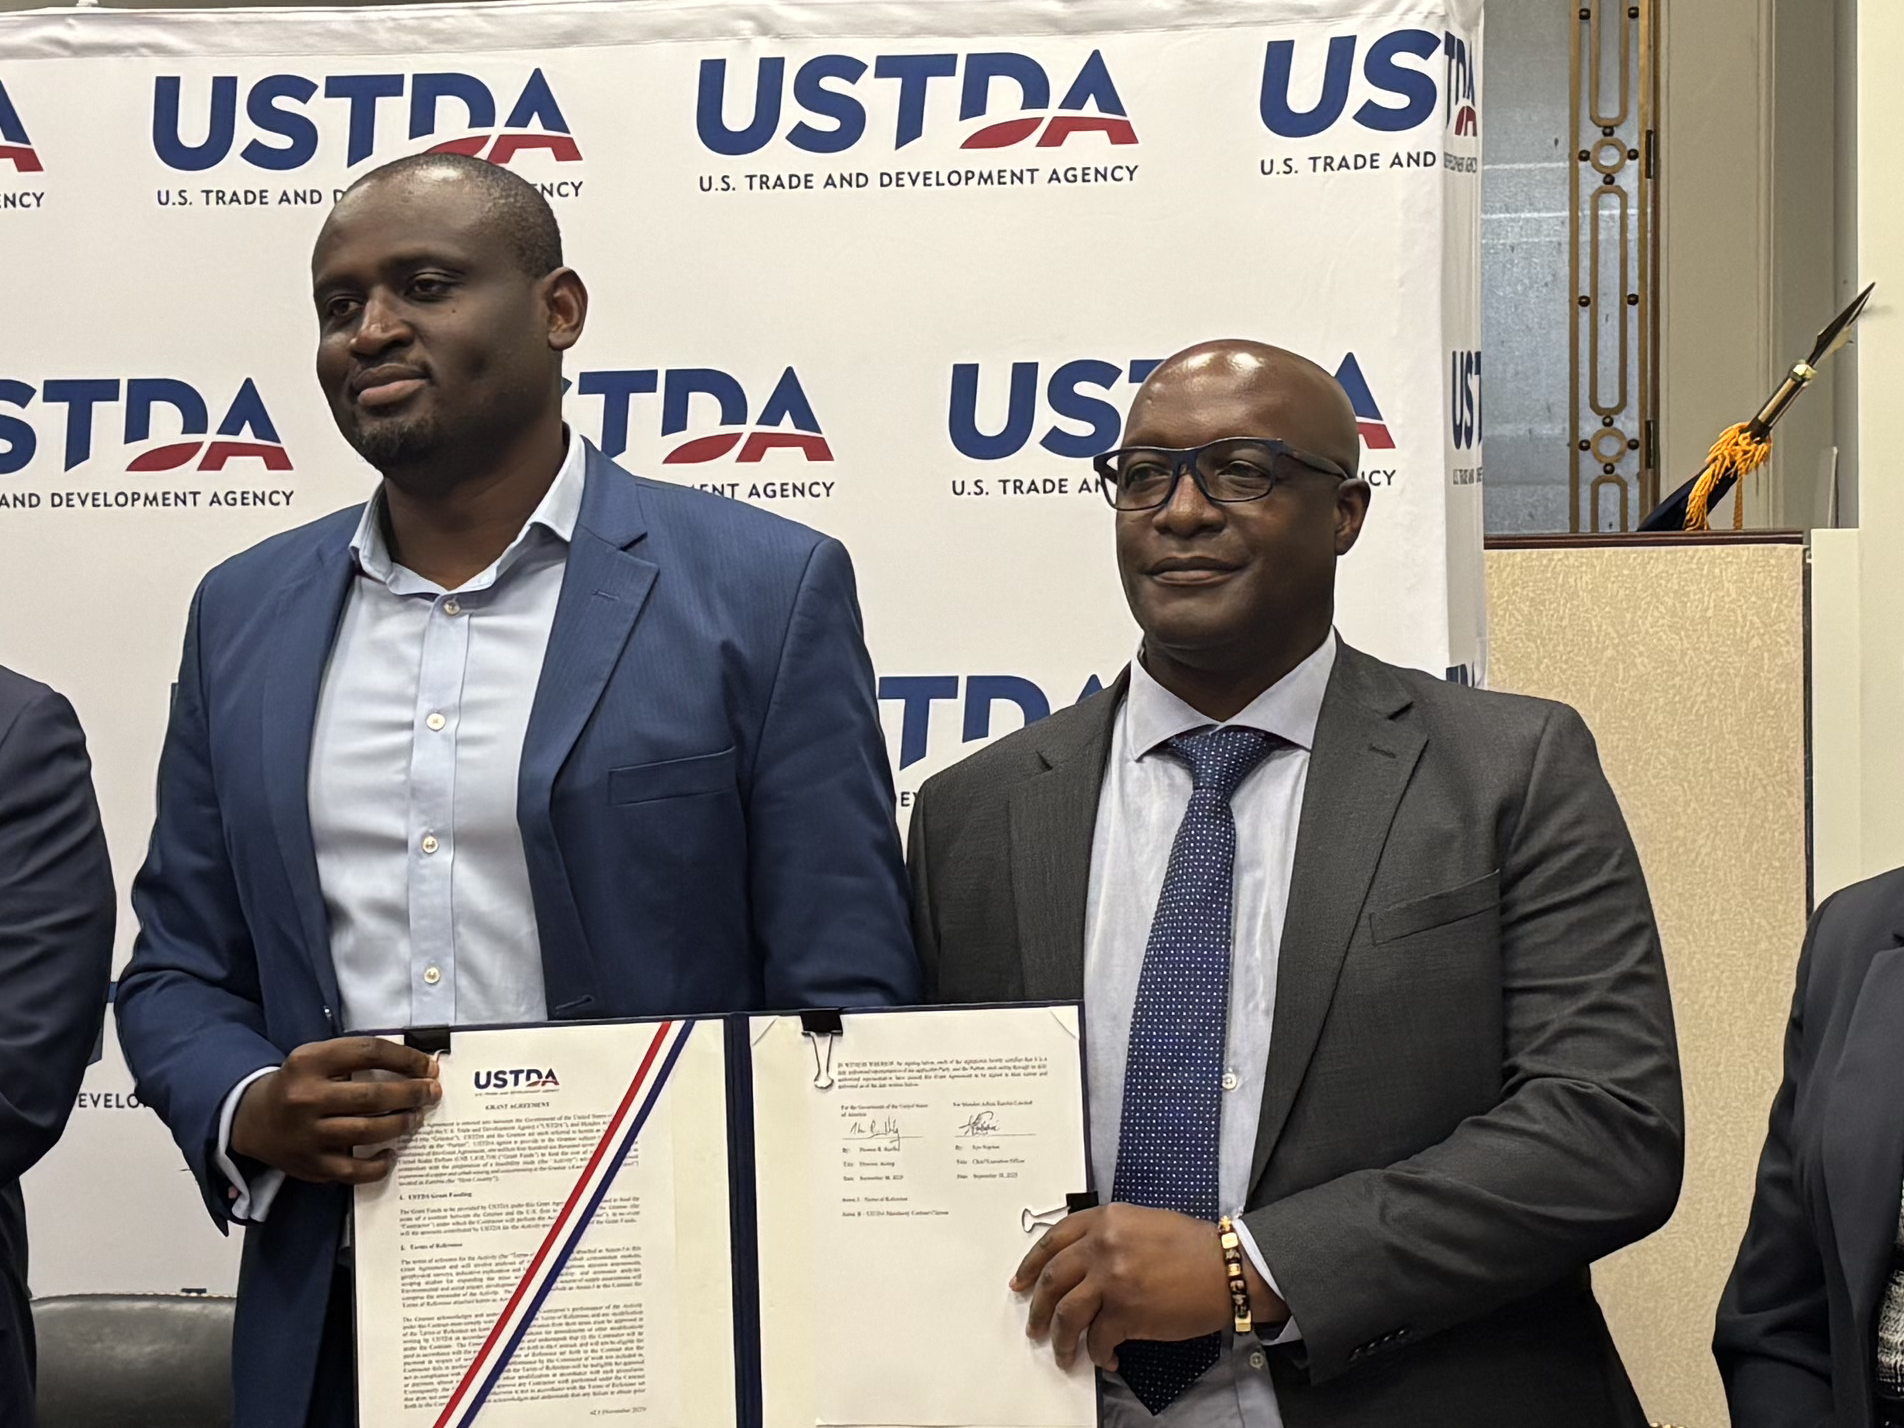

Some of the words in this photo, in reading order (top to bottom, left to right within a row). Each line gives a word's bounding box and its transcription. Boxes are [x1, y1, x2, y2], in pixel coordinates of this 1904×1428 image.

[696, 49, 1139, 155] USTDA
[152, 68, 583, 171] USTDA
[1260, 157, 1299, 176] U.S.
[1308, 152, 1381, 173] TRADE
[1389, 150, 1437, 169] AND
[699, 174, 736, 193] U.S.
[744, 173, 815, 191] TRADE
[823, 172, 869, 190] AND
[879, 168, 1040, 189] DEVELOPMENT
[1047, 164, 1139, 184] AGENCY
[157, 189, 193, 206] U.S.
[201, 189, 269, 206] TRADE
[278, 189, 323, 206] AND
[747, 481, 835, 499] AGENCY
[951, 479, 989, 496] U.S.
[997, 477, 1069, 495] TRADE
[50, 490, 202, 509] DEVELOPMENT
[208, 489, 294, 507] AGENCY
[474, 1068, 560, 1090] USTDA
